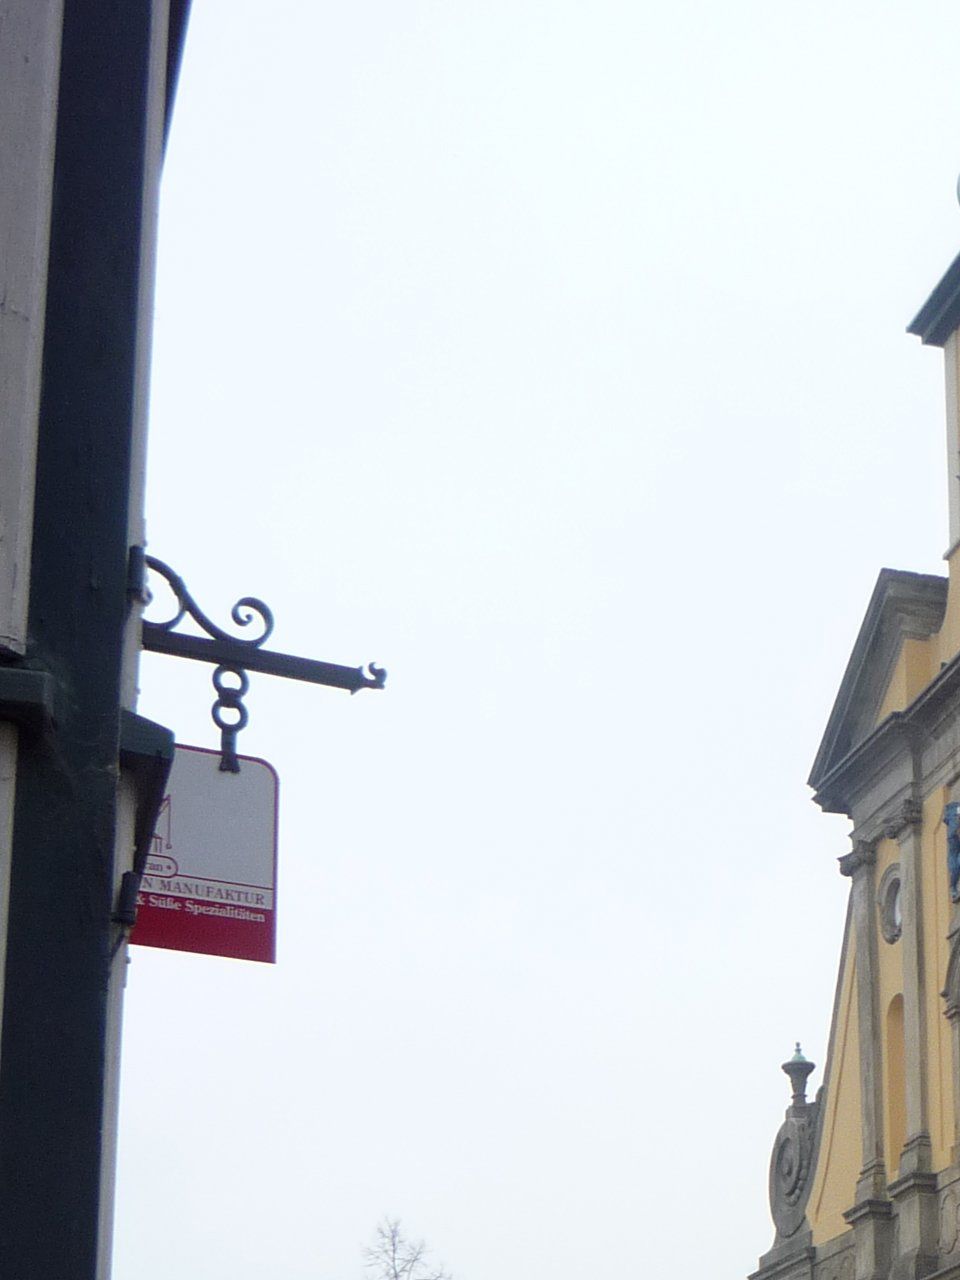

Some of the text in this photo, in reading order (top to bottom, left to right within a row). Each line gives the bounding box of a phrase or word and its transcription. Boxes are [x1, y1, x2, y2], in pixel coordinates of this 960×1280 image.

[160, 879, 265, 905] MANUFAKTUR
[149, 895, 182, 910] Süße
[185, 900, 265, 922] Spezialitäten
